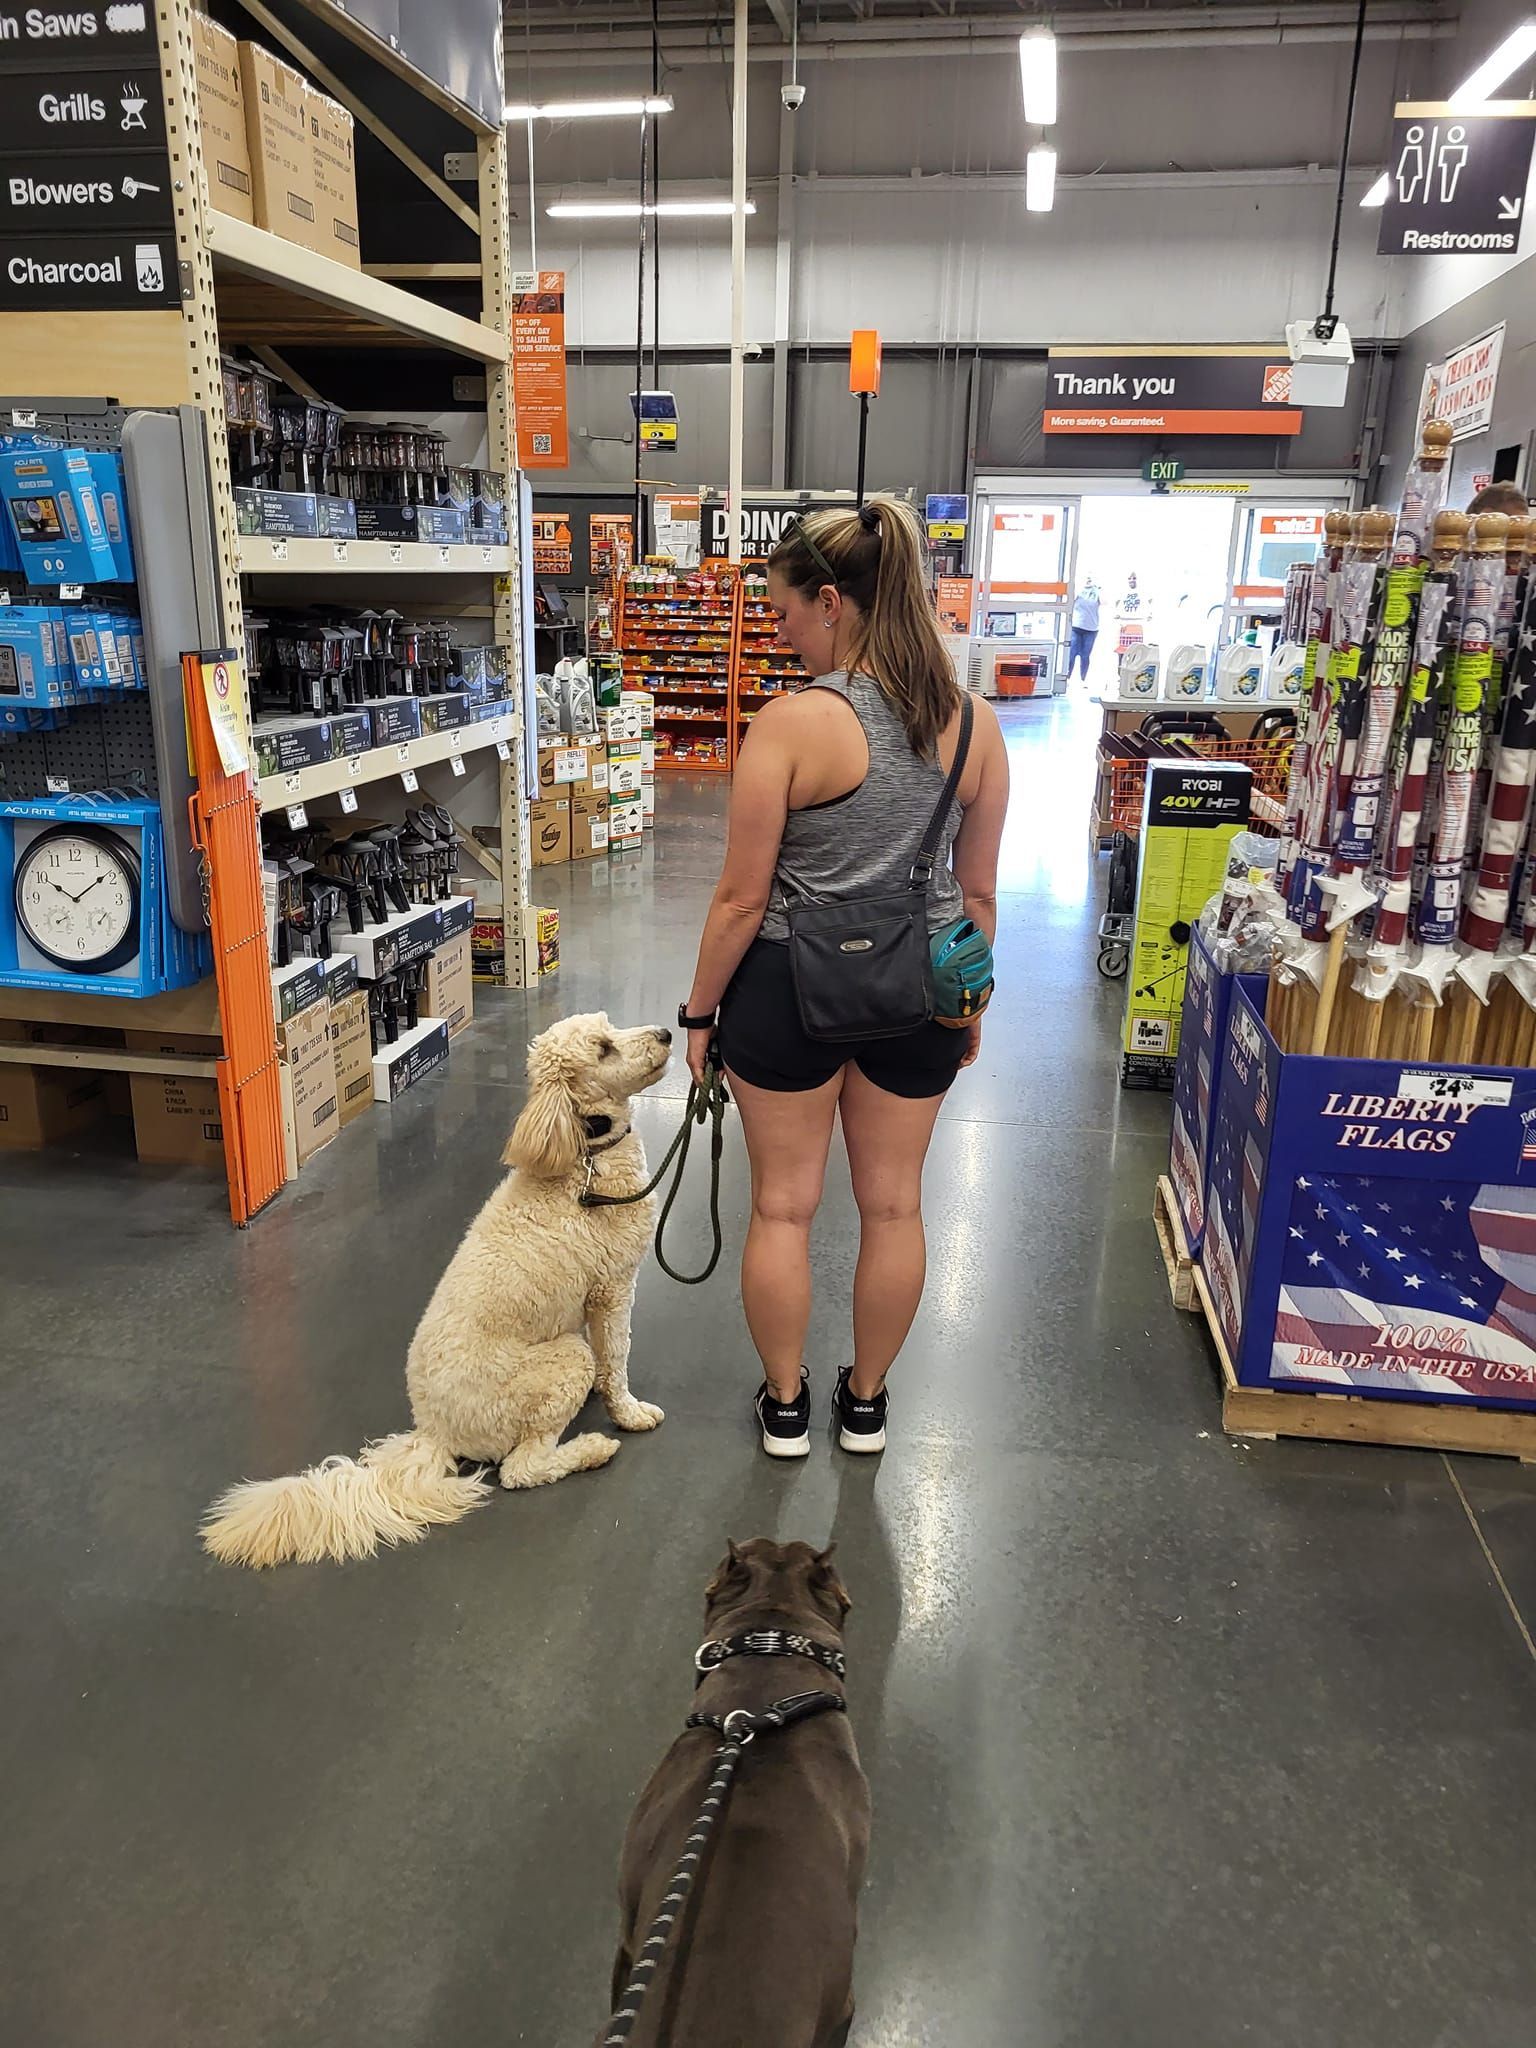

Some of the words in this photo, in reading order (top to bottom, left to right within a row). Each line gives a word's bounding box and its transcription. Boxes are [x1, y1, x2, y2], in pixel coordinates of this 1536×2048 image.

[25, 9, 98, 38] Saws
[39, 93, 106, 122] Grills
[9, 178, 114, 205] Blowers
[1402, 230, 1515, 249] Restrooms
[8, 256, 122, 284] Charcoal
[1053, 373, 1126, 395] Thank
[1132, 379, 1175, 399] you
[1051, 416, 1075, 426] More
[1076, 417, 1108, 427] saving.
[1109, 417, 1165, 426] Guaranteed.
[1151, 462, 1179, 478] EXIT
[712, 542, 725, 554] IN
[1385, 648, 1408, 663] THE
[1370, 663, 1404, 687] USA
[1458, 733, 1480, 748] THE
[1446, 749, 1478, 772] USA
[1182, 779, 1222, 791] RYOBI
[1160, 795, 1203, 808] 40V
[1205, 797, 1240, 808] HP
[4, 806, 29, 814] ACU
[31, 808, 56, 816] RITE
[50, 854, 60, 868] 11
[68, 849, 82, 862] 12
[94, 854, 100, 868] 1
[36, 871, 48, 883] 10
[108, 873, 117, 885] 2
[32, 891, 40, 904] 9
[114, 893, 123, 905] 3
[77, 937, 85, 950] 6
[400, 944, 424, 963] HAMPTON
[424, 939, 433, 951] BAY
[1230, 1043, 1249, 1086] FLAGS
[1320, 1093, 1482, 1124] LIBERTY
[1336, 1124, 1457, 1152] FLAGS
[1371, 1323, 1468, 1353] 100%
[1294, 1347, 1375, 1370] MADE
[1379, 1355, 1414, 1373] IN
[1417, 1357, 1476, 1378] THE
[1482, 1363, 1536, 1384] USA
